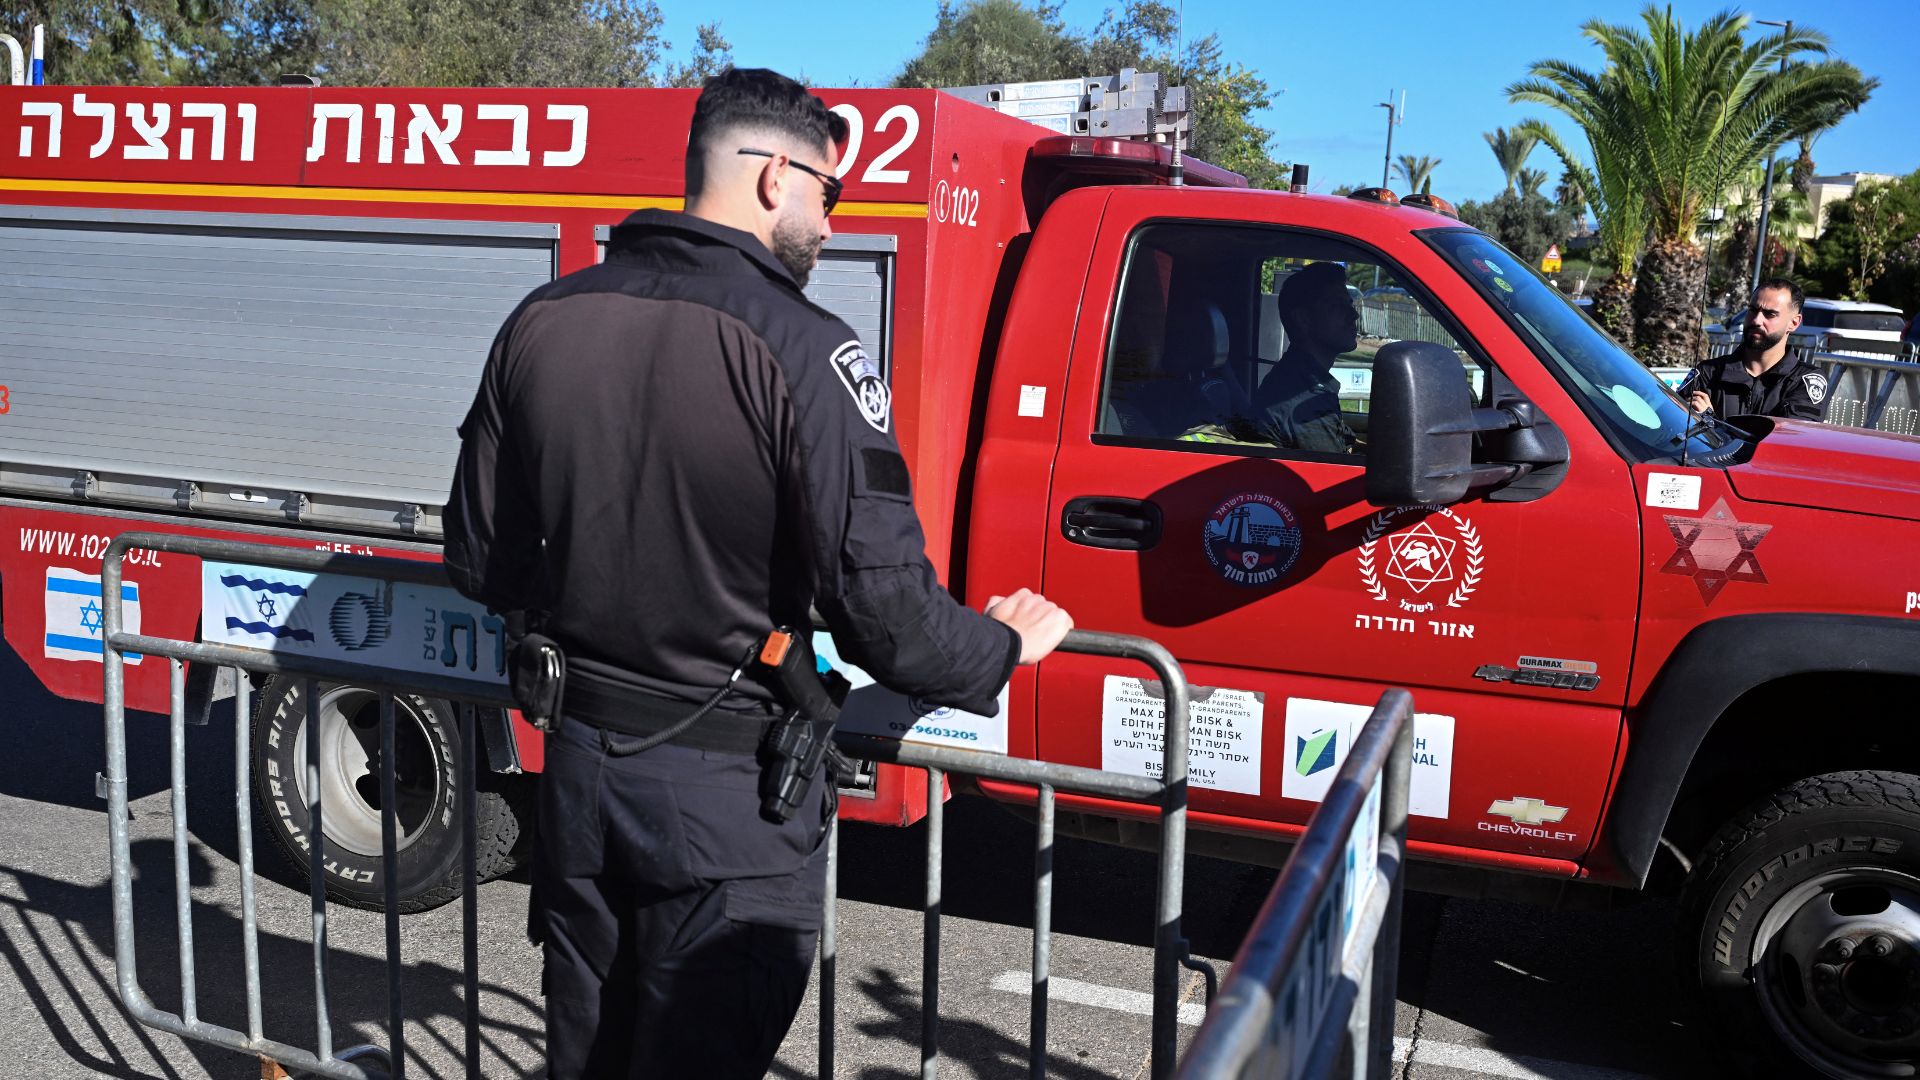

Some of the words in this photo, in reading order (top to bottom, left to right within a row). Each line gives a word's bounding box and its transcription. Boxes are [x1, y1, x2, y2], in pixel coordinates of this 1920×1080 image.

[18, 93, 257, 162] והצלה
[306, 102, 589, 168] כבאות
[952, 186, 979, 227] 102
[1216, 495, 1244, 516] לישראל
[1223, 563, 1245, 583] חוף
[1248, 567, 1278, 584] מחוז
[1399, 598, 1434, 613] לישראל
[1355, 614, 1415, 633] חדרה
[1428, 620, 1475, 638] אזור
[1520, 657, 1562, 668] DURAMAX
[1130, 707, 1154, 718] MAX
[1196, 715, 1222, 726] BISK
[1226, 718, 1233, 728] &
[889, 721, 978, 741] 03-9603205
[1121, 718, 1154, 730] EDITH
[1216, 729, 1242, 741] BISK
[1113, 738, 1143, 749] הערש
[1205, 740, 1230, 750] משה
[1219, 752, 1249, 763] אסתר
[1477, 822, 1577, 842] CHEVROLET
[1712, 835, 1904, 967] WINDFORCE
